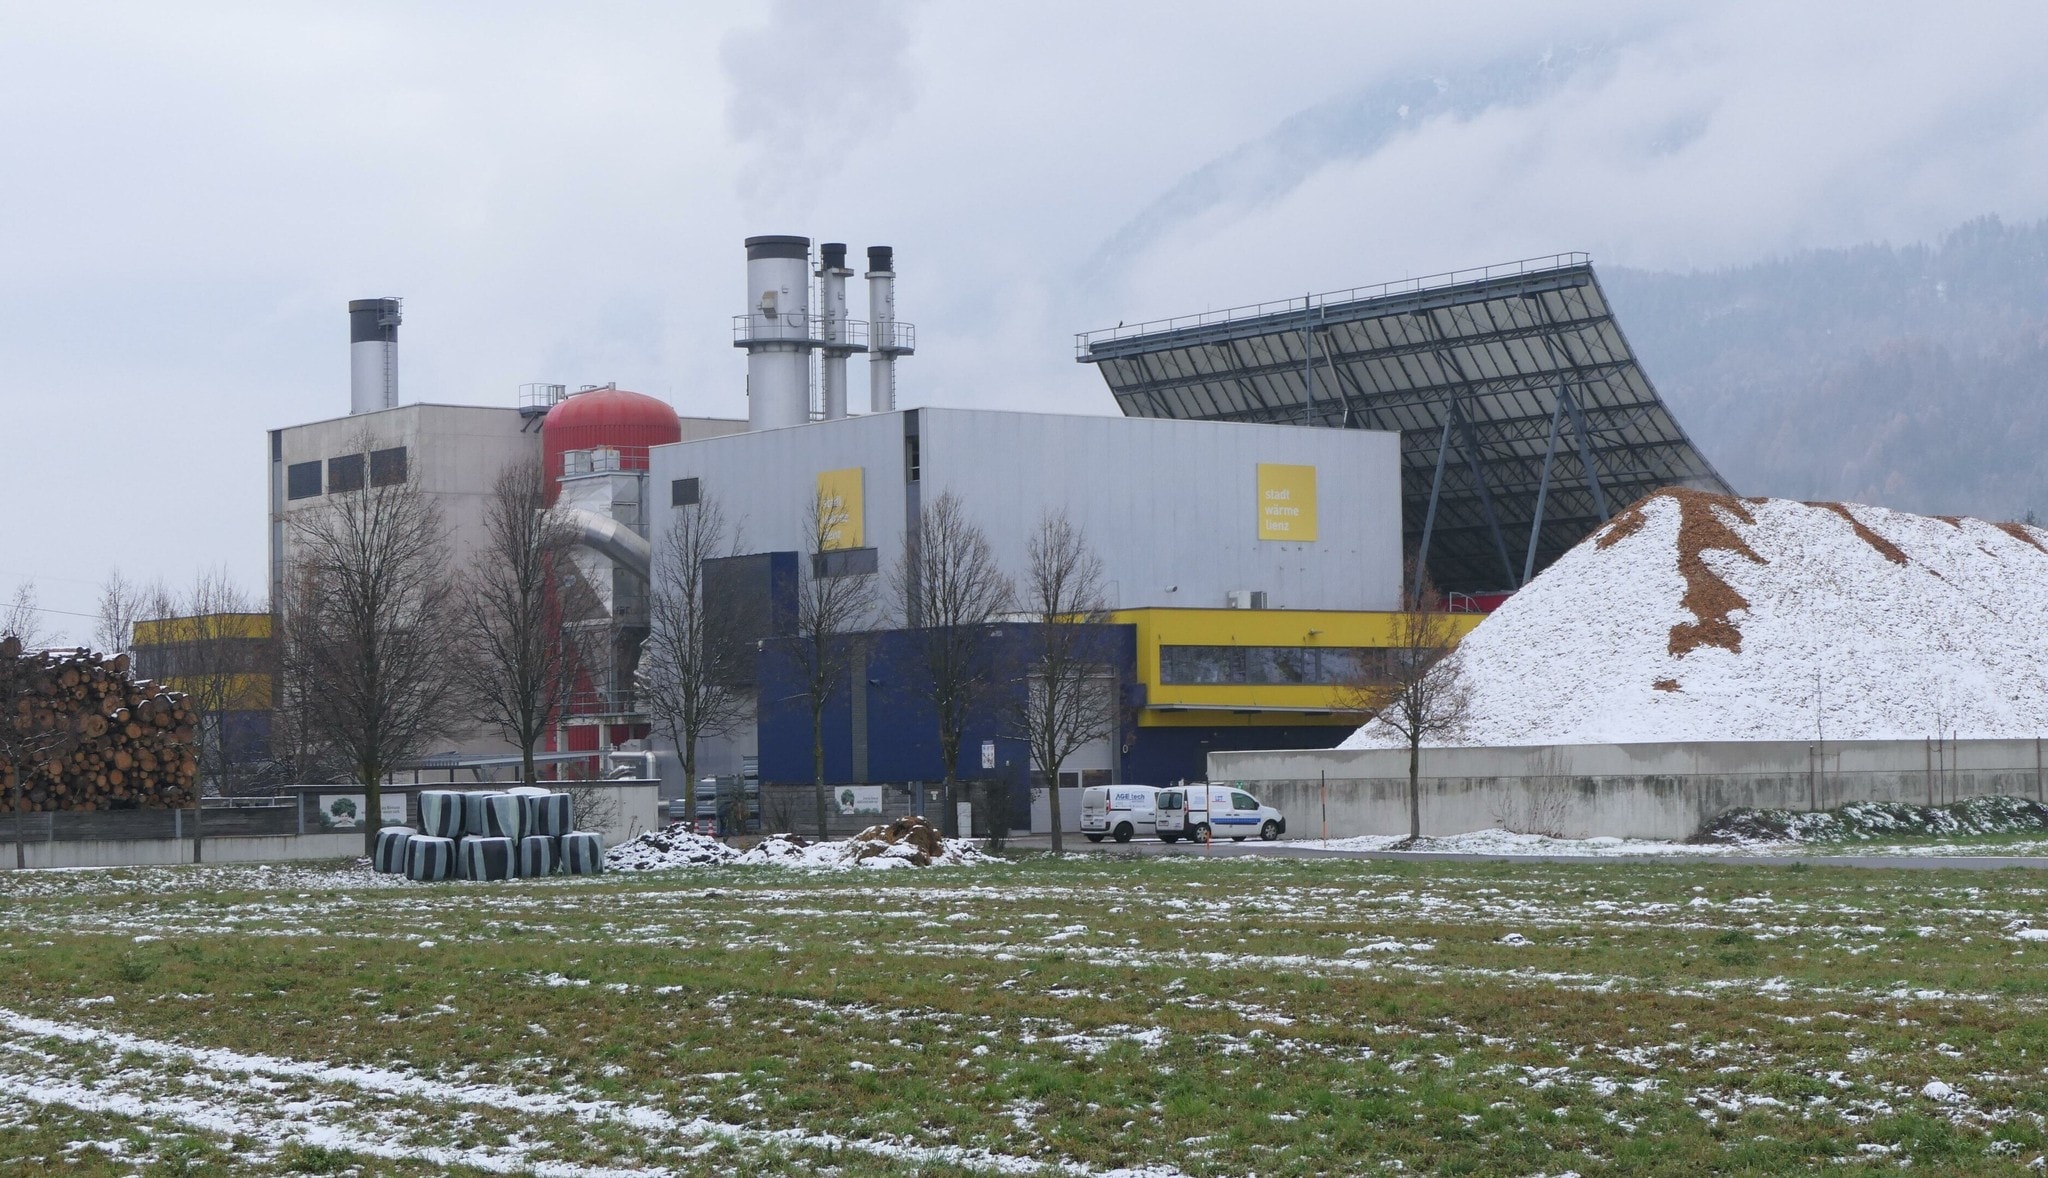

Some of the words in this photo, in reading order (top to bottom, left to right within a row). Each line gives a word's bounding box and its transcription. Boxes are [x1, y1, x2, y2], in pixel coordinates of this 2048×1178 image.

[1265, 489, 1290, 500] stadt
[1265, 504, 1299, 516] wärme
[1266, 519, 1289, 531] lienz
